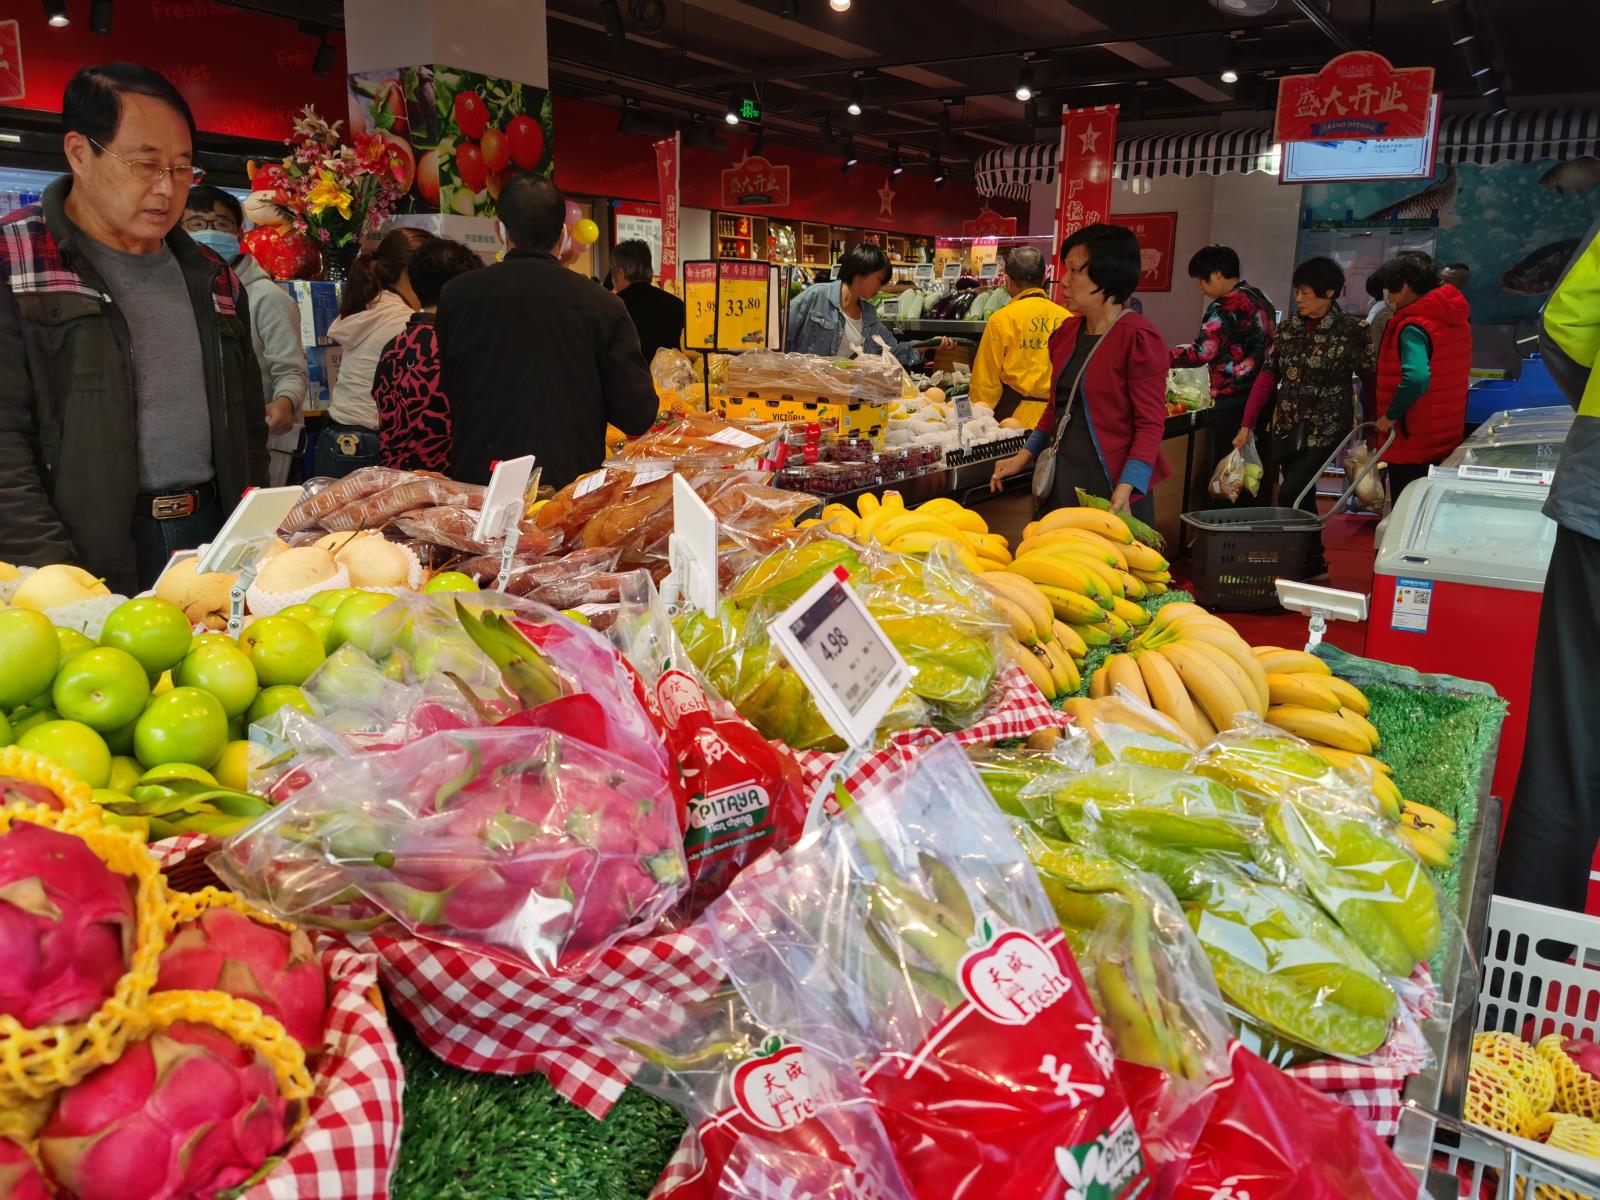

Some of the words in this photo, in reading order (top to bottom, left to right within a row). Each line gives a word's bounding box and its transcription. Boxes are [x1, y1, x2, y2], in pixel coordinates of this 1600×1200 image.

[1295, 81, 1409, 117] 盛大开业
[730, 172, 780, 193] 盛大开业
[725, 297, 761, 317] 33.80
[772, 412, 805, 422] VICTORIA
[820, 626, 849, 662] 4.98
[698, 789, 763, 820] PITAYA
[1005, 971, 1066, 1018] Fresh
